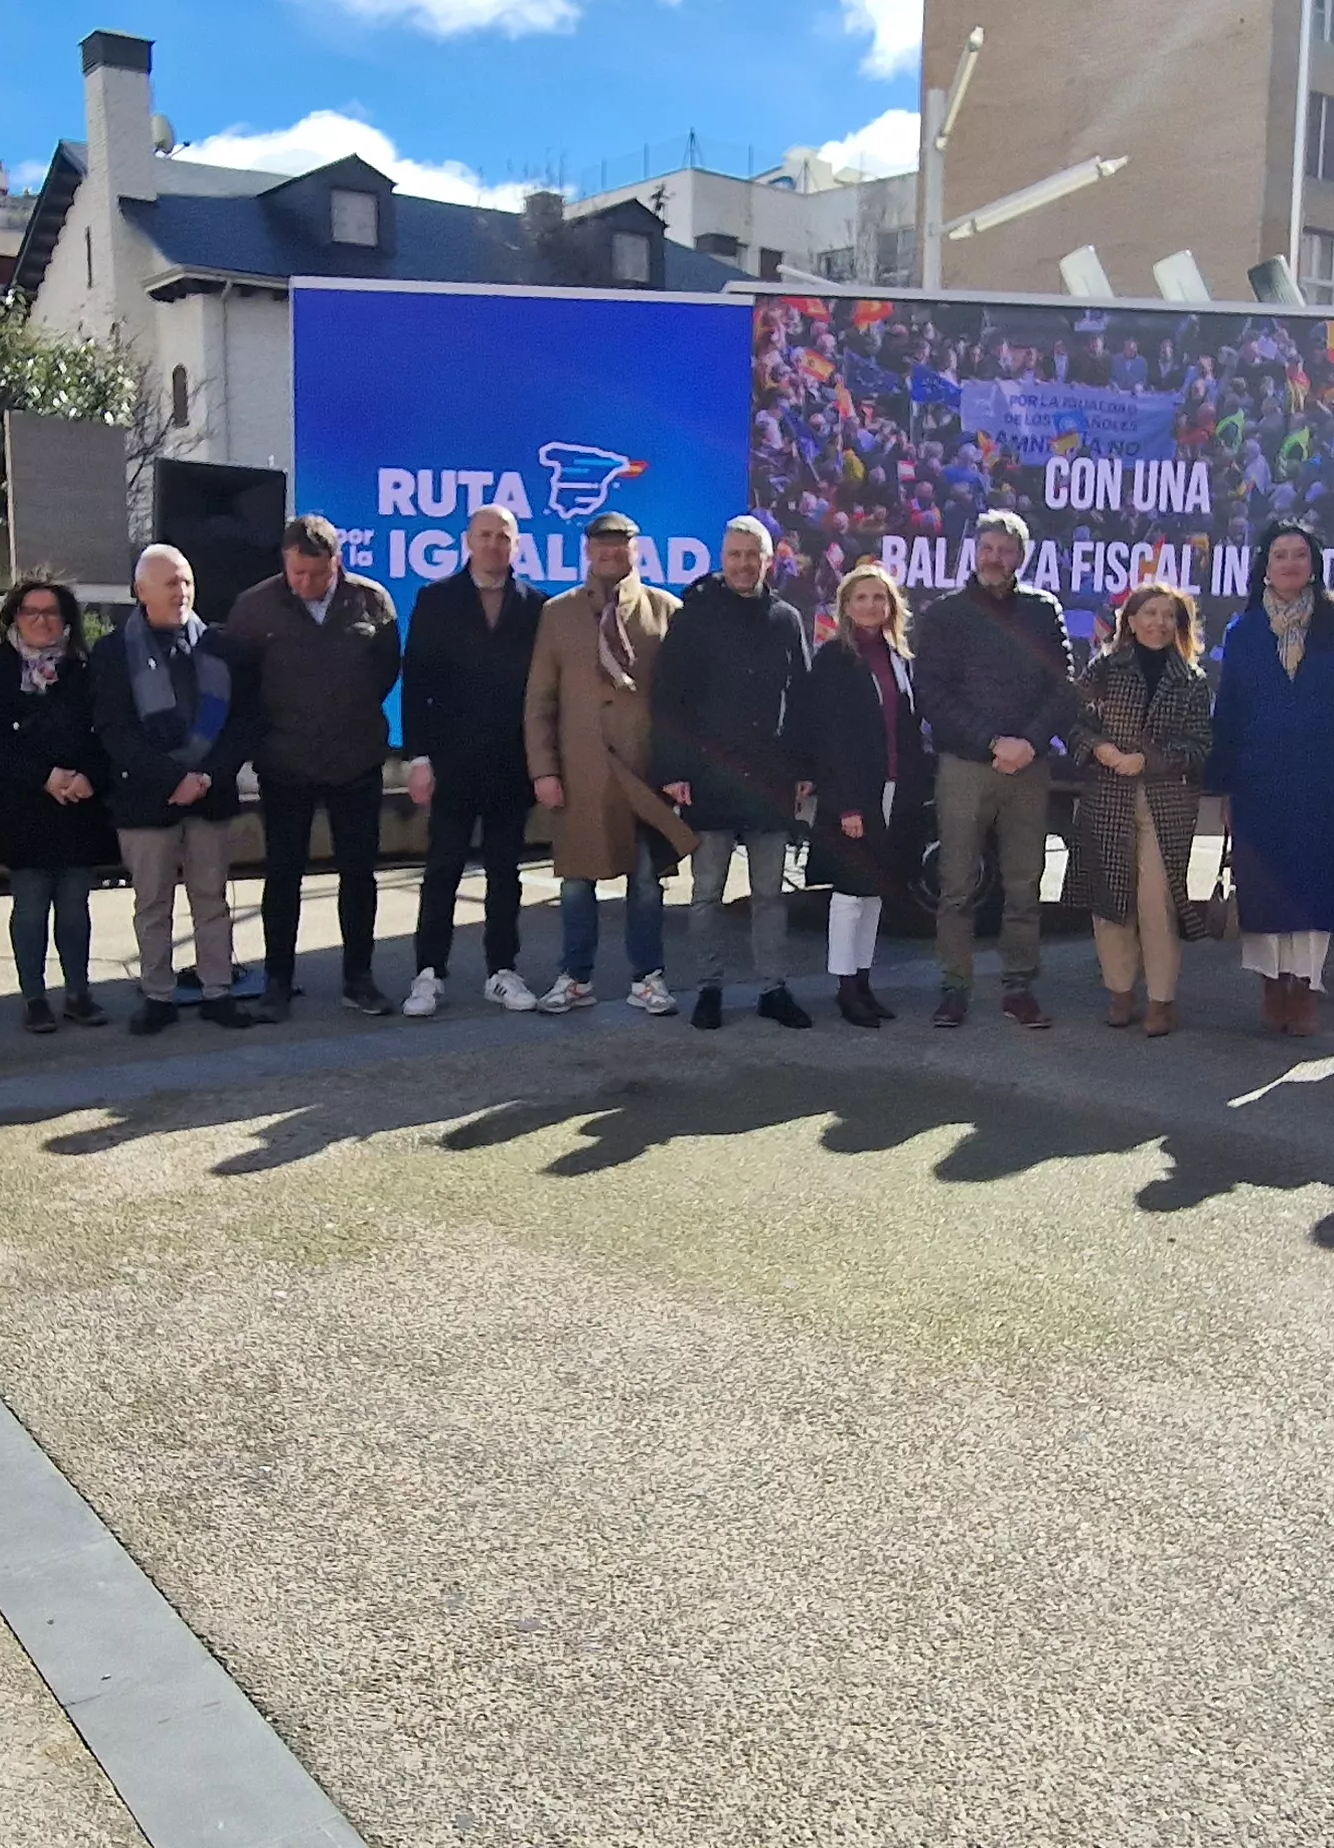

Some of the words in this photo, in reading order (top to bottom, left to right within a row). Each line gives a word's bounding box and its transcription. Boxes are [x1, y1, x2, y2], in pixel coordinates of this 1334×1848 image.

[1041, 393, 1058, 408] LA
[378, 468, 533, 519] RUTA
[1045, 456, 1122, 511] CON
[1133, 459, 1211, 513] UNA
[335, 528, 375, 551] por
[349, 544, 373, 567] la
[389, 529, 710, 584] IGALAD
[882, 535, 1060, 592] BALAZA
[1071, 541, 1201, 595] FISCAL
